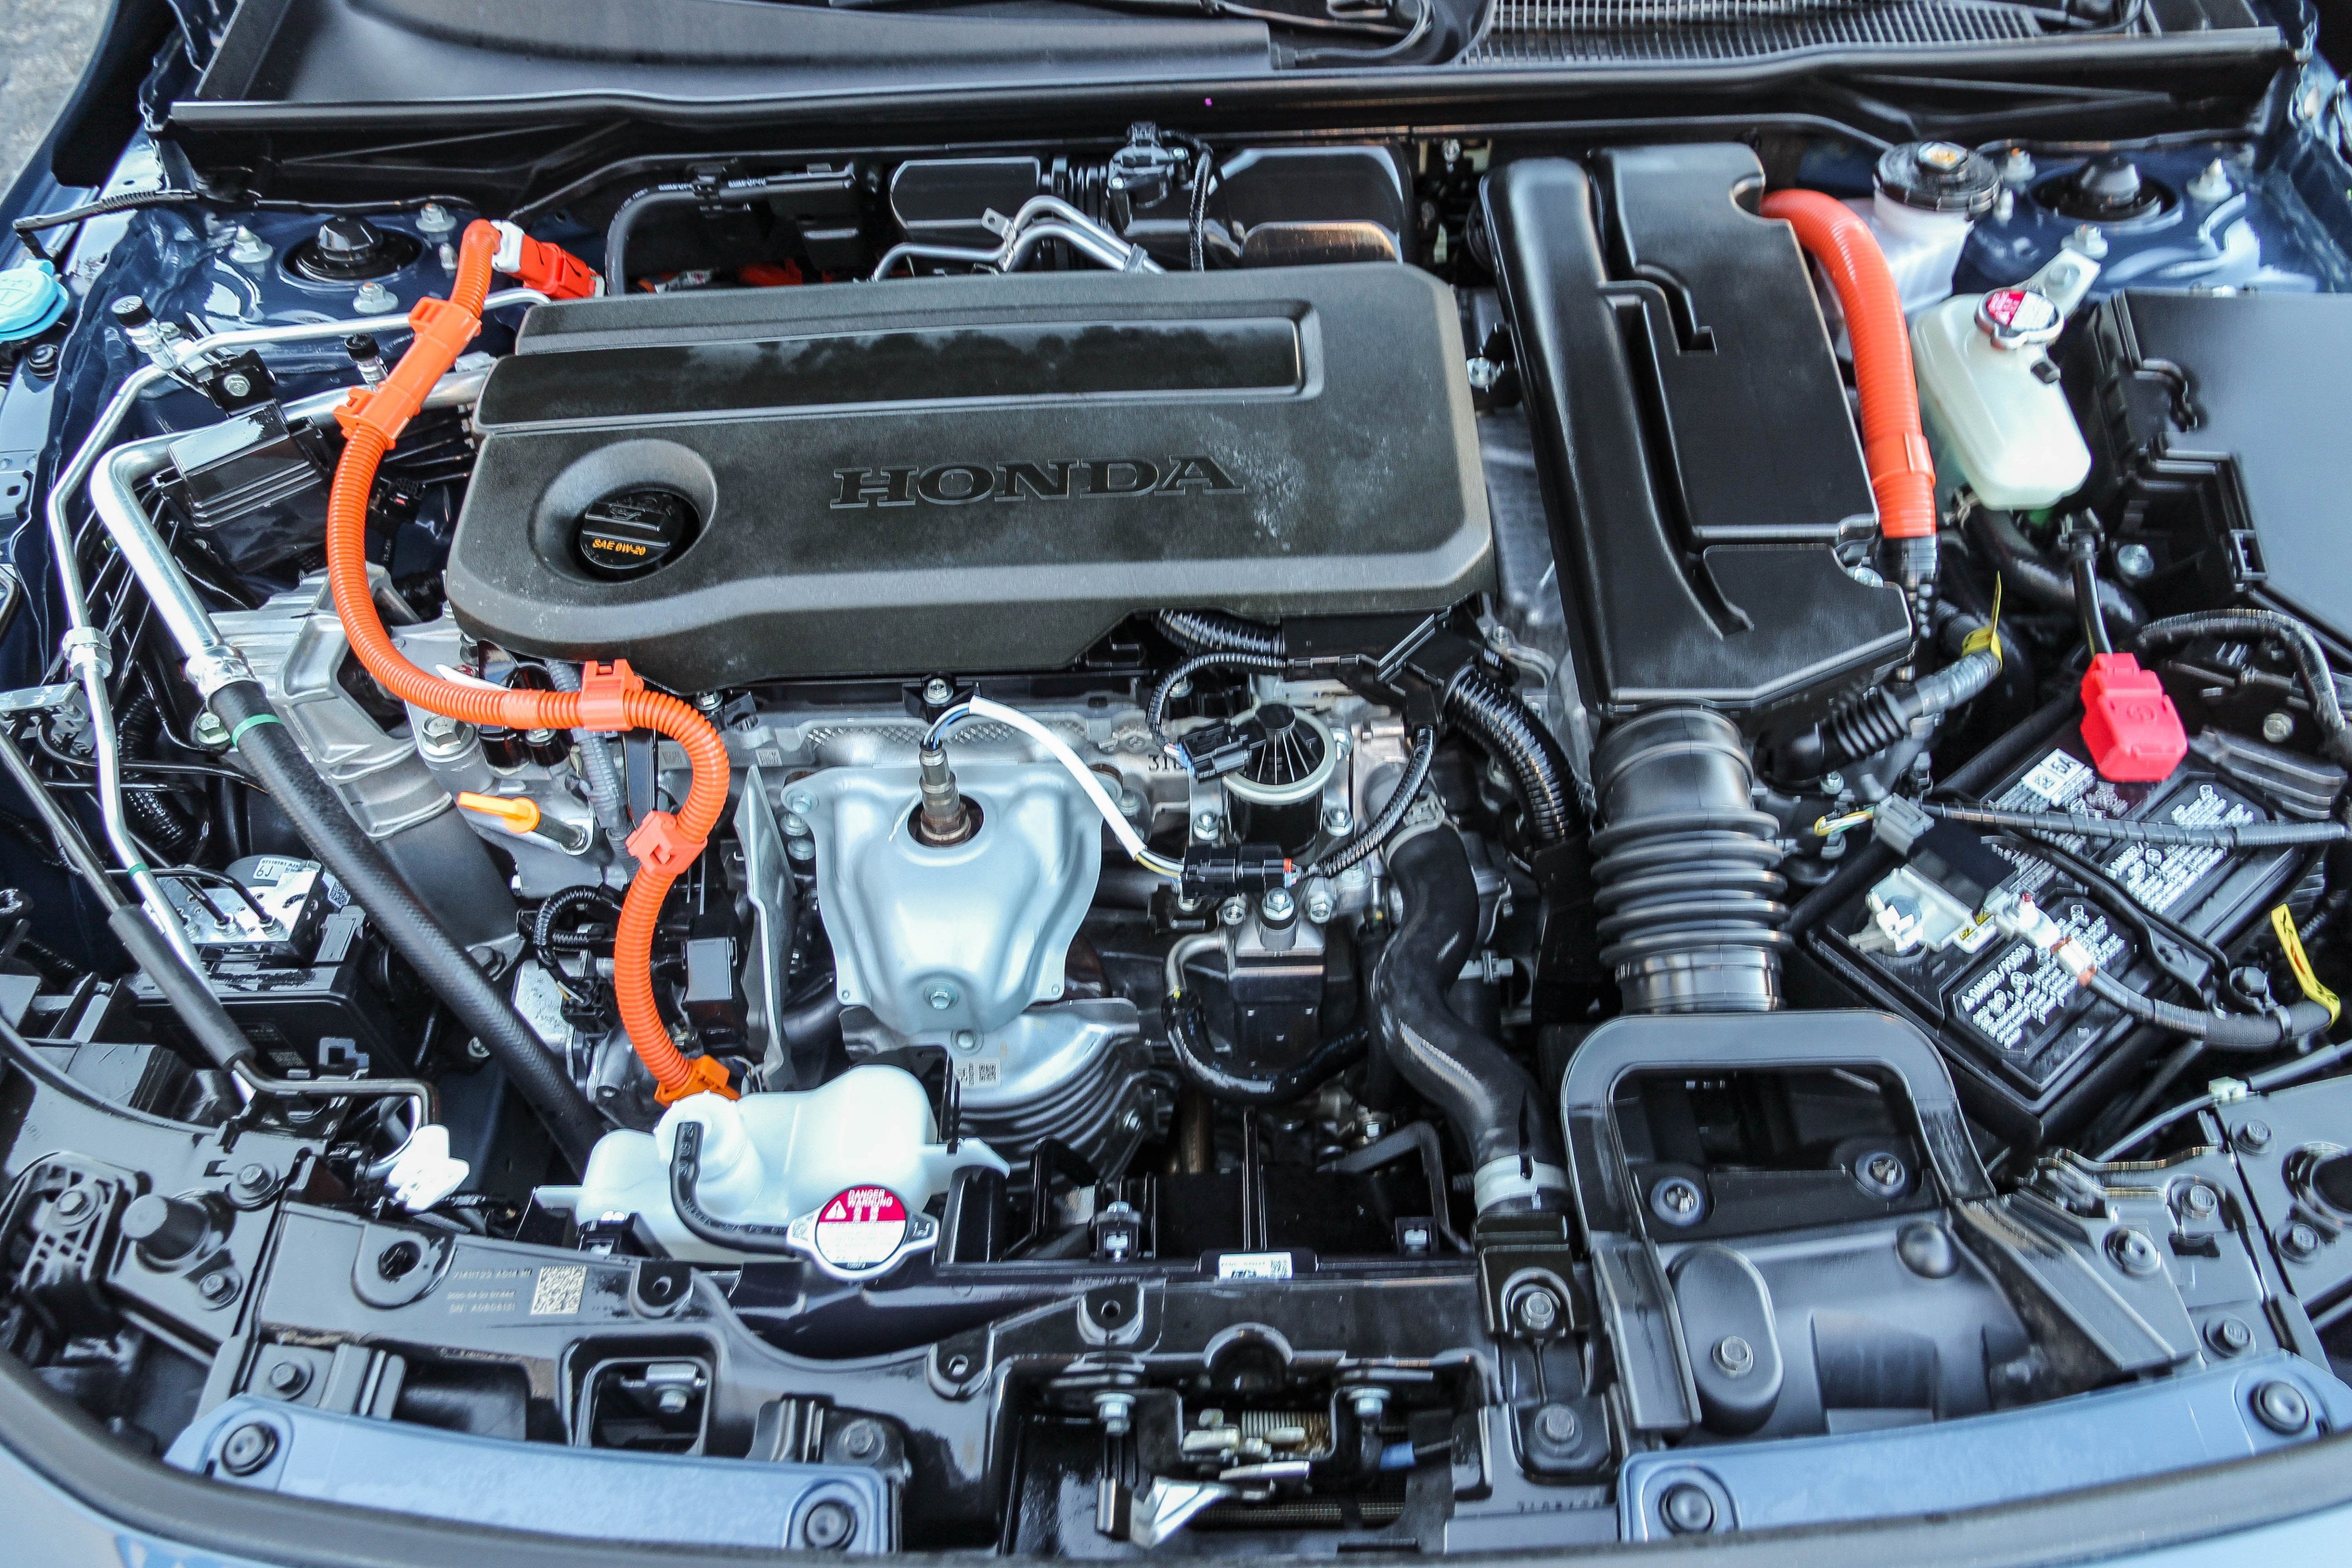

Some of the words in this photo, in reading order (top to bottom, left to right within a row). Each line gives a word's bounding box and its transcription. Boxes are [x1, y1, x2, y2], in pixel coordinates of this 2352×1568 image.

[830, 455, 1246, 509] HONDA
[592, 538, 615, 550] SAE
[615, 542, 646, 556] 0W-20
[2050, 756, 2078, 774] 5A
[256, 865, 274, 877] 6J
[848, 1188, 885, 1201] DANGER
